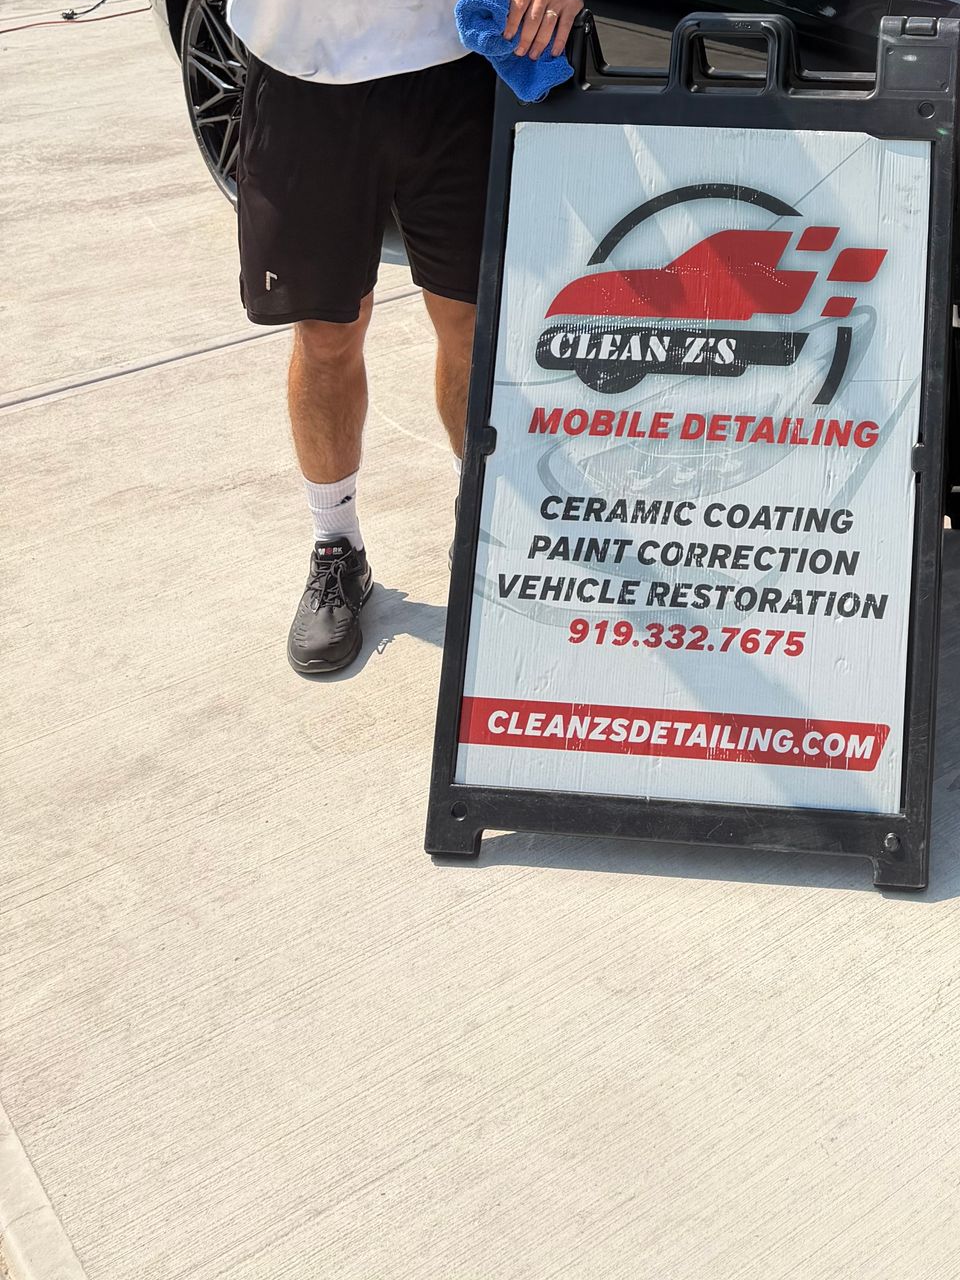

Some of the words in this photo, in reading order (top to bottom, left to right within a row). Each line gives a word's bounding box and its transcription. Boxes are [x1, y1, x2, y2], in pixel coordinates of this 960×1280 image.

[549, 332, 672, 363] CLEAN
[683, 336, 737, 365] Z'S
[528, 407, 674, 439] MOBILE
[680, 413, 880, 449] DETAILING
[540, 495, 696, 527] CERAMIC
[703, 502, 854, 535] COATING
[527, 535, 633, 564] PAINT
[637, 540, 860, 576] CORRECTION
[498, 573, 640, 606] VEHICLE
[646, 581, 889, 620] RESTORATION
[567, 618, 807, 657] 919.332.7675
[487, 709, 876, 760] CLEANZSDETAILING.COM
